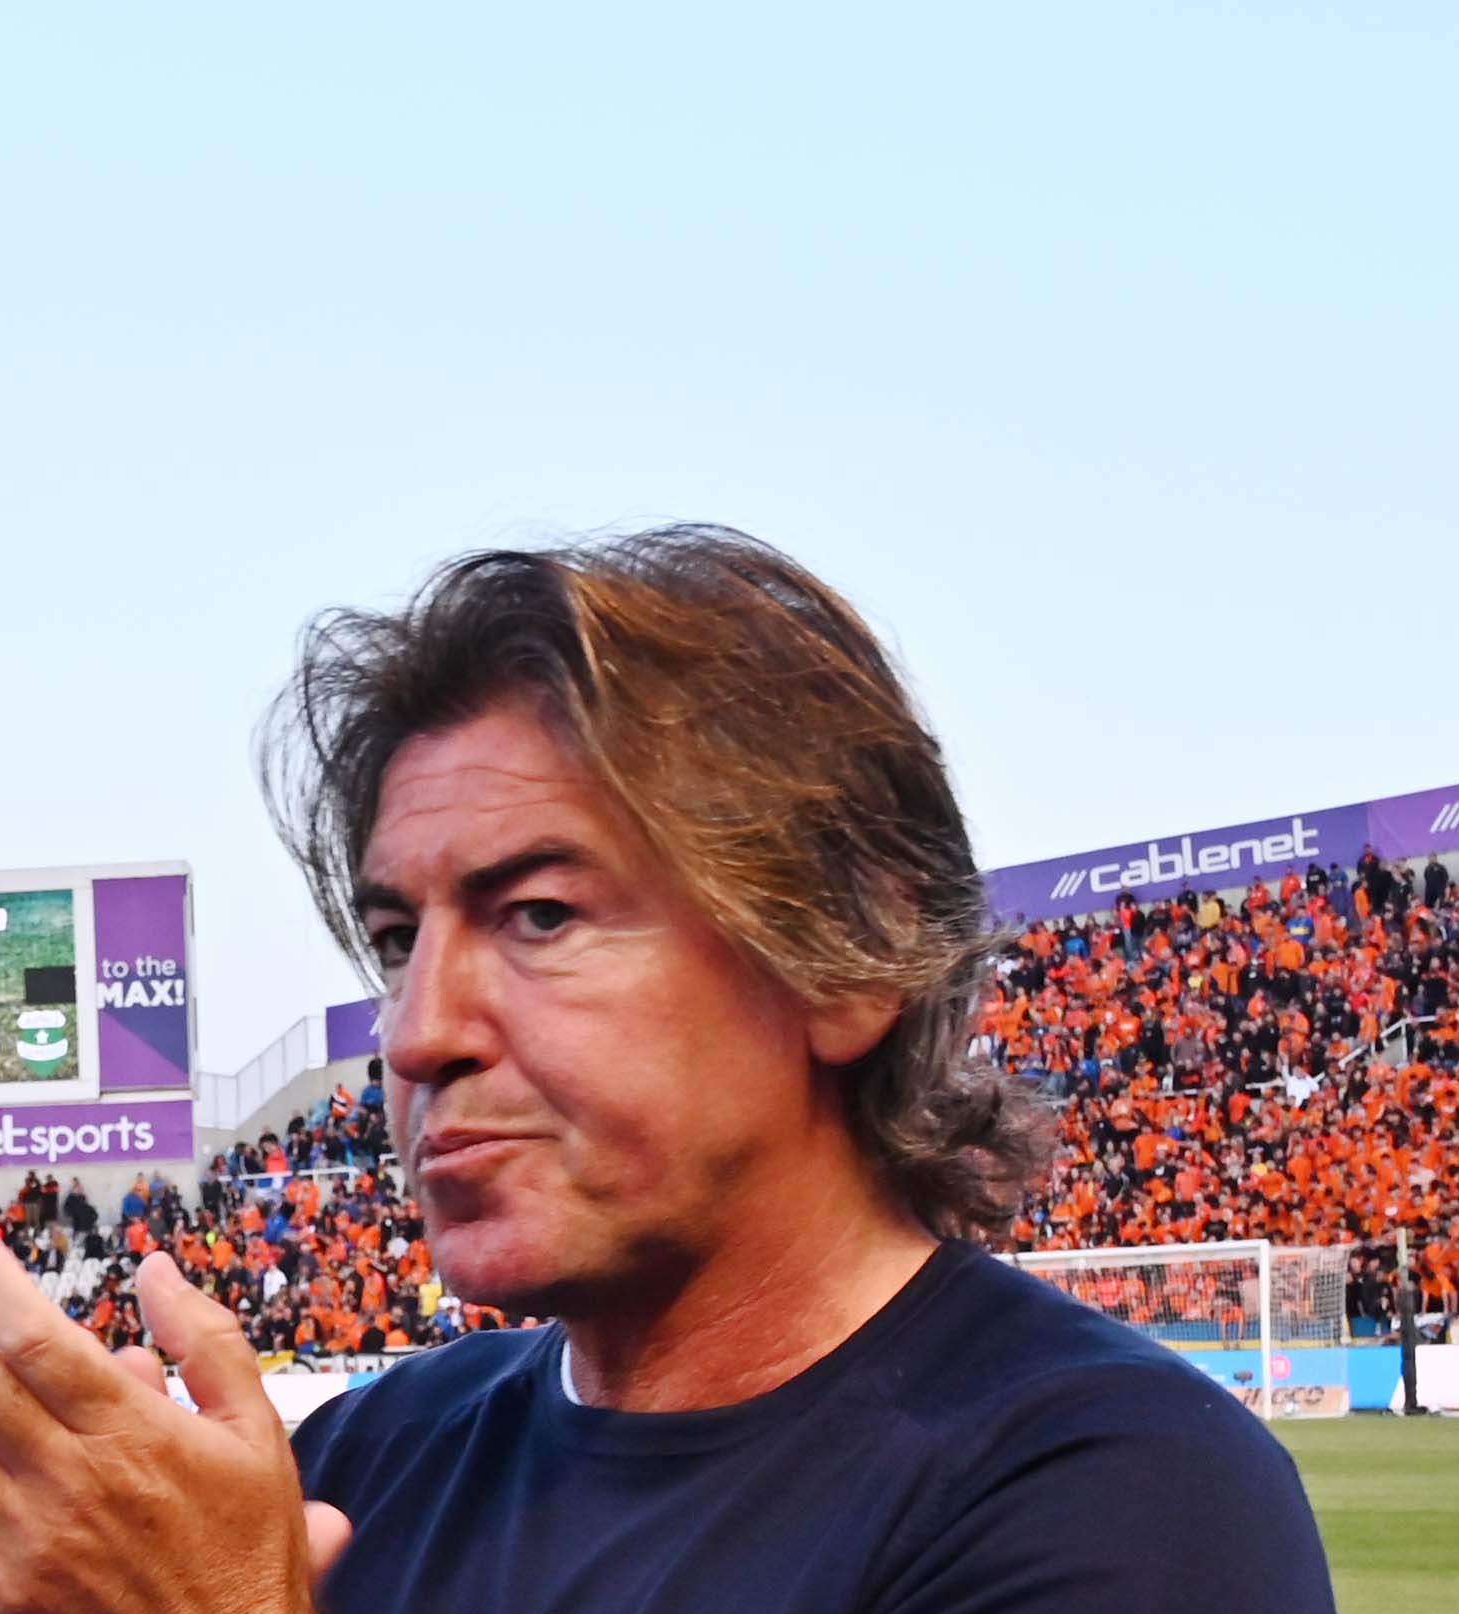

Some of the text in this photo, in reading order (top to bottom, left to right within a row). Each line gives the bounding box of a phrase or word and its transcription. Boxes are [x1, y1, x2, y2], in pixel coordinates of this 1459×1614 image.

[1089, 818, 1320, 893] cablenet
[102, 955, 176, 979] to the
[95, 979, 185, 1009] MAX!
